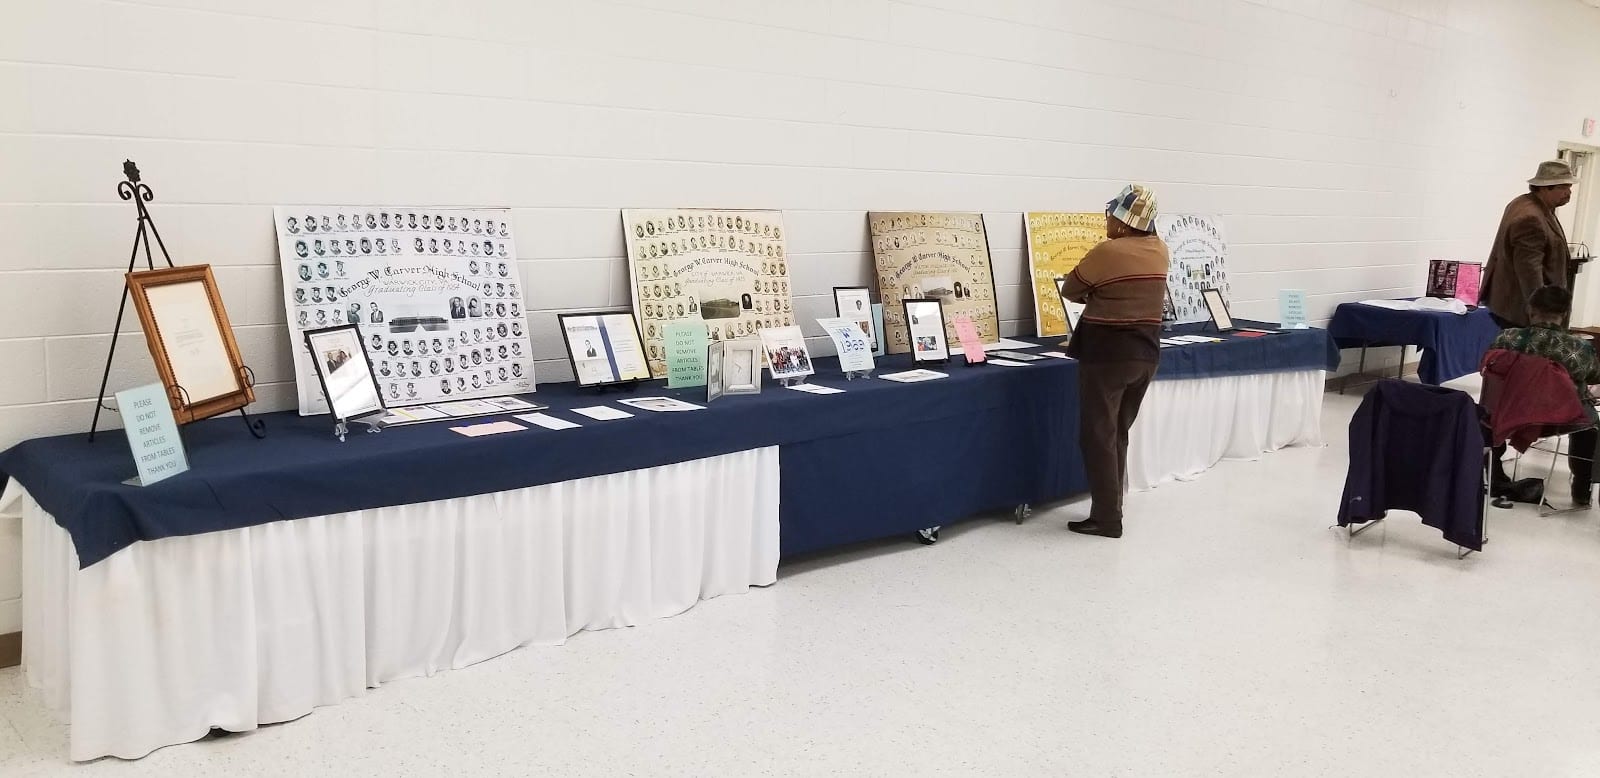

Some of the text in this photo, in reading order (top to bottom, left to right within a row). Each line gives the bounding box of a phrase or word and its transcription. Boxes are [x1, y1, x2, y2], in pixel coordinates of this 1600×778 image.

[918, 252, 936, 260] Carver
[937, 251, 950, 262] High
[724, 258, 738, 267] High
[740, 261, 760, 276] School
[384, 263, 421, 277] Carver
[422, 264, 449, 279] High
[450, 271, 481, 291] School
[364, 285, 417, 297] Graduating
[133, 399, 152, 408] PLEASE
[136, 410, 156, 422] DO NOT
[139, 424, 160, 434] REMOVE
[143, 436, 166, 448] ARTICLES
[141, 447, 176, 463] FROM TABLES
[147, 460, 177, 474] THANK YOU
